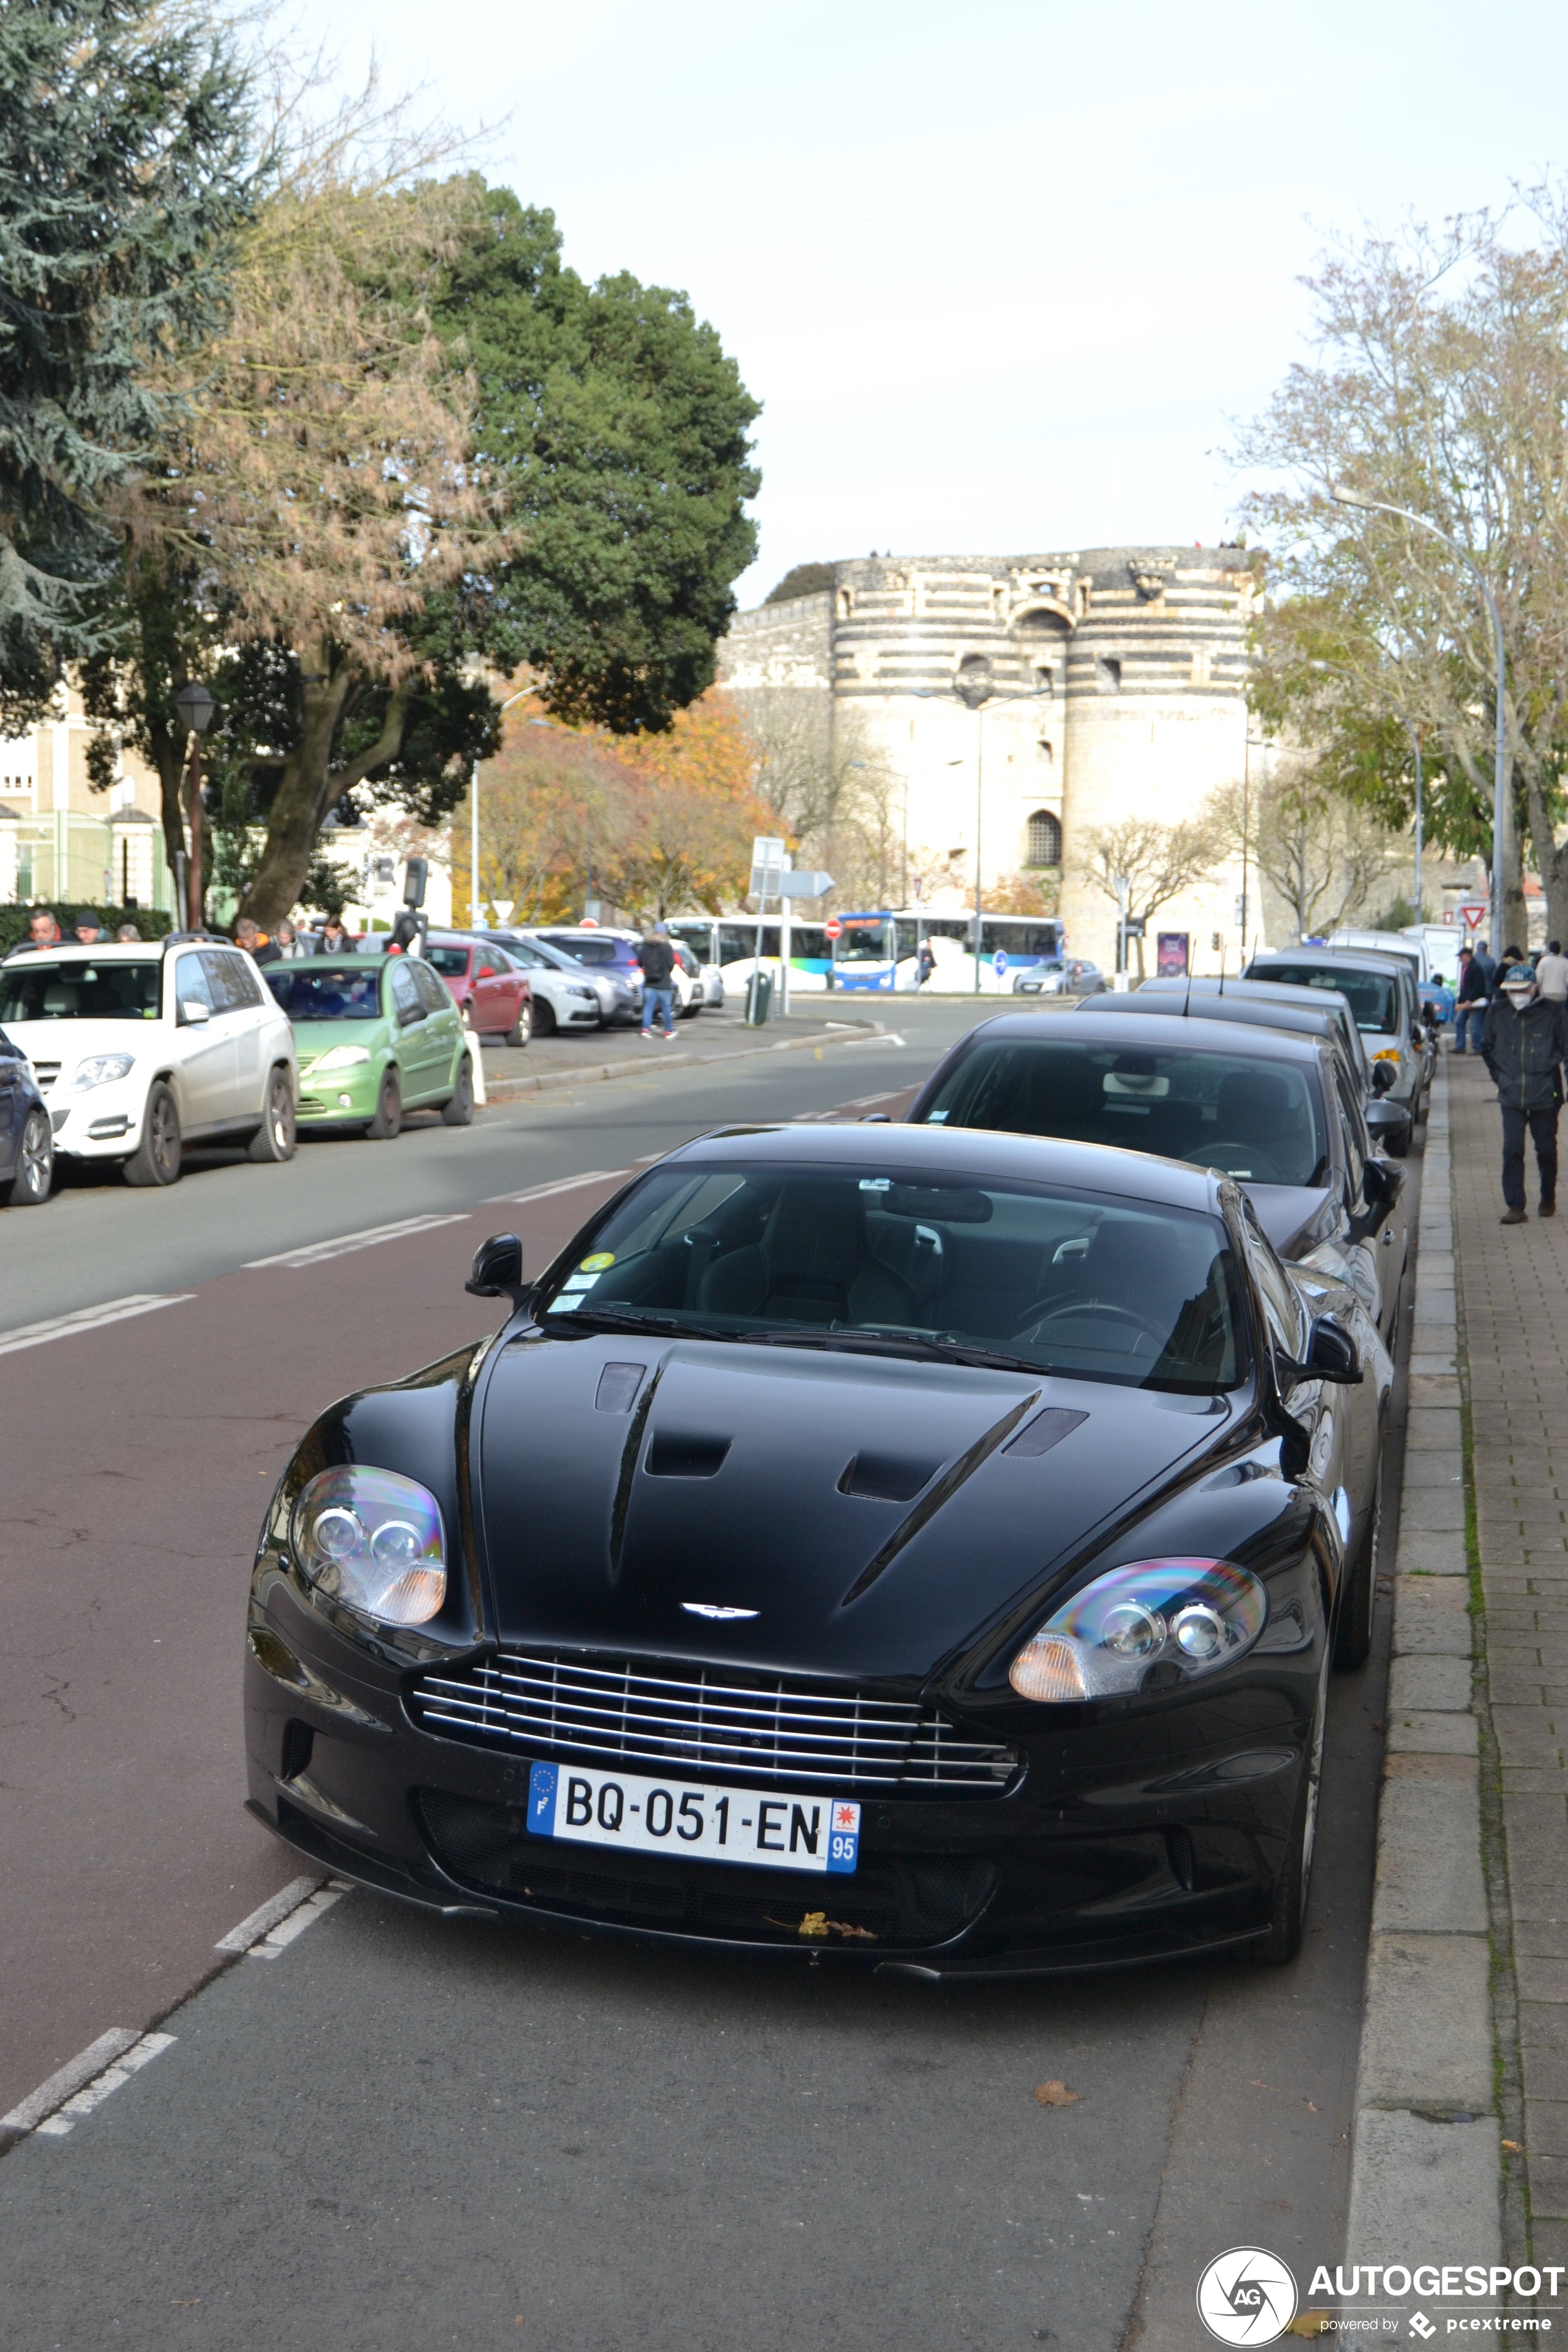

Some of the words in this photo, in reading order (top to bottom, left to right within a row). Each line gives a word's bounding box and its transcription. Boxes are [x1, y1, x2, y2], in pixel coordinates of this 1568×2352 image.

[537, 1800, 546, 1814] F
[566, 1777, 819, 1854] BQ-051-EN
[832, 1837, 854, 1859] 95
